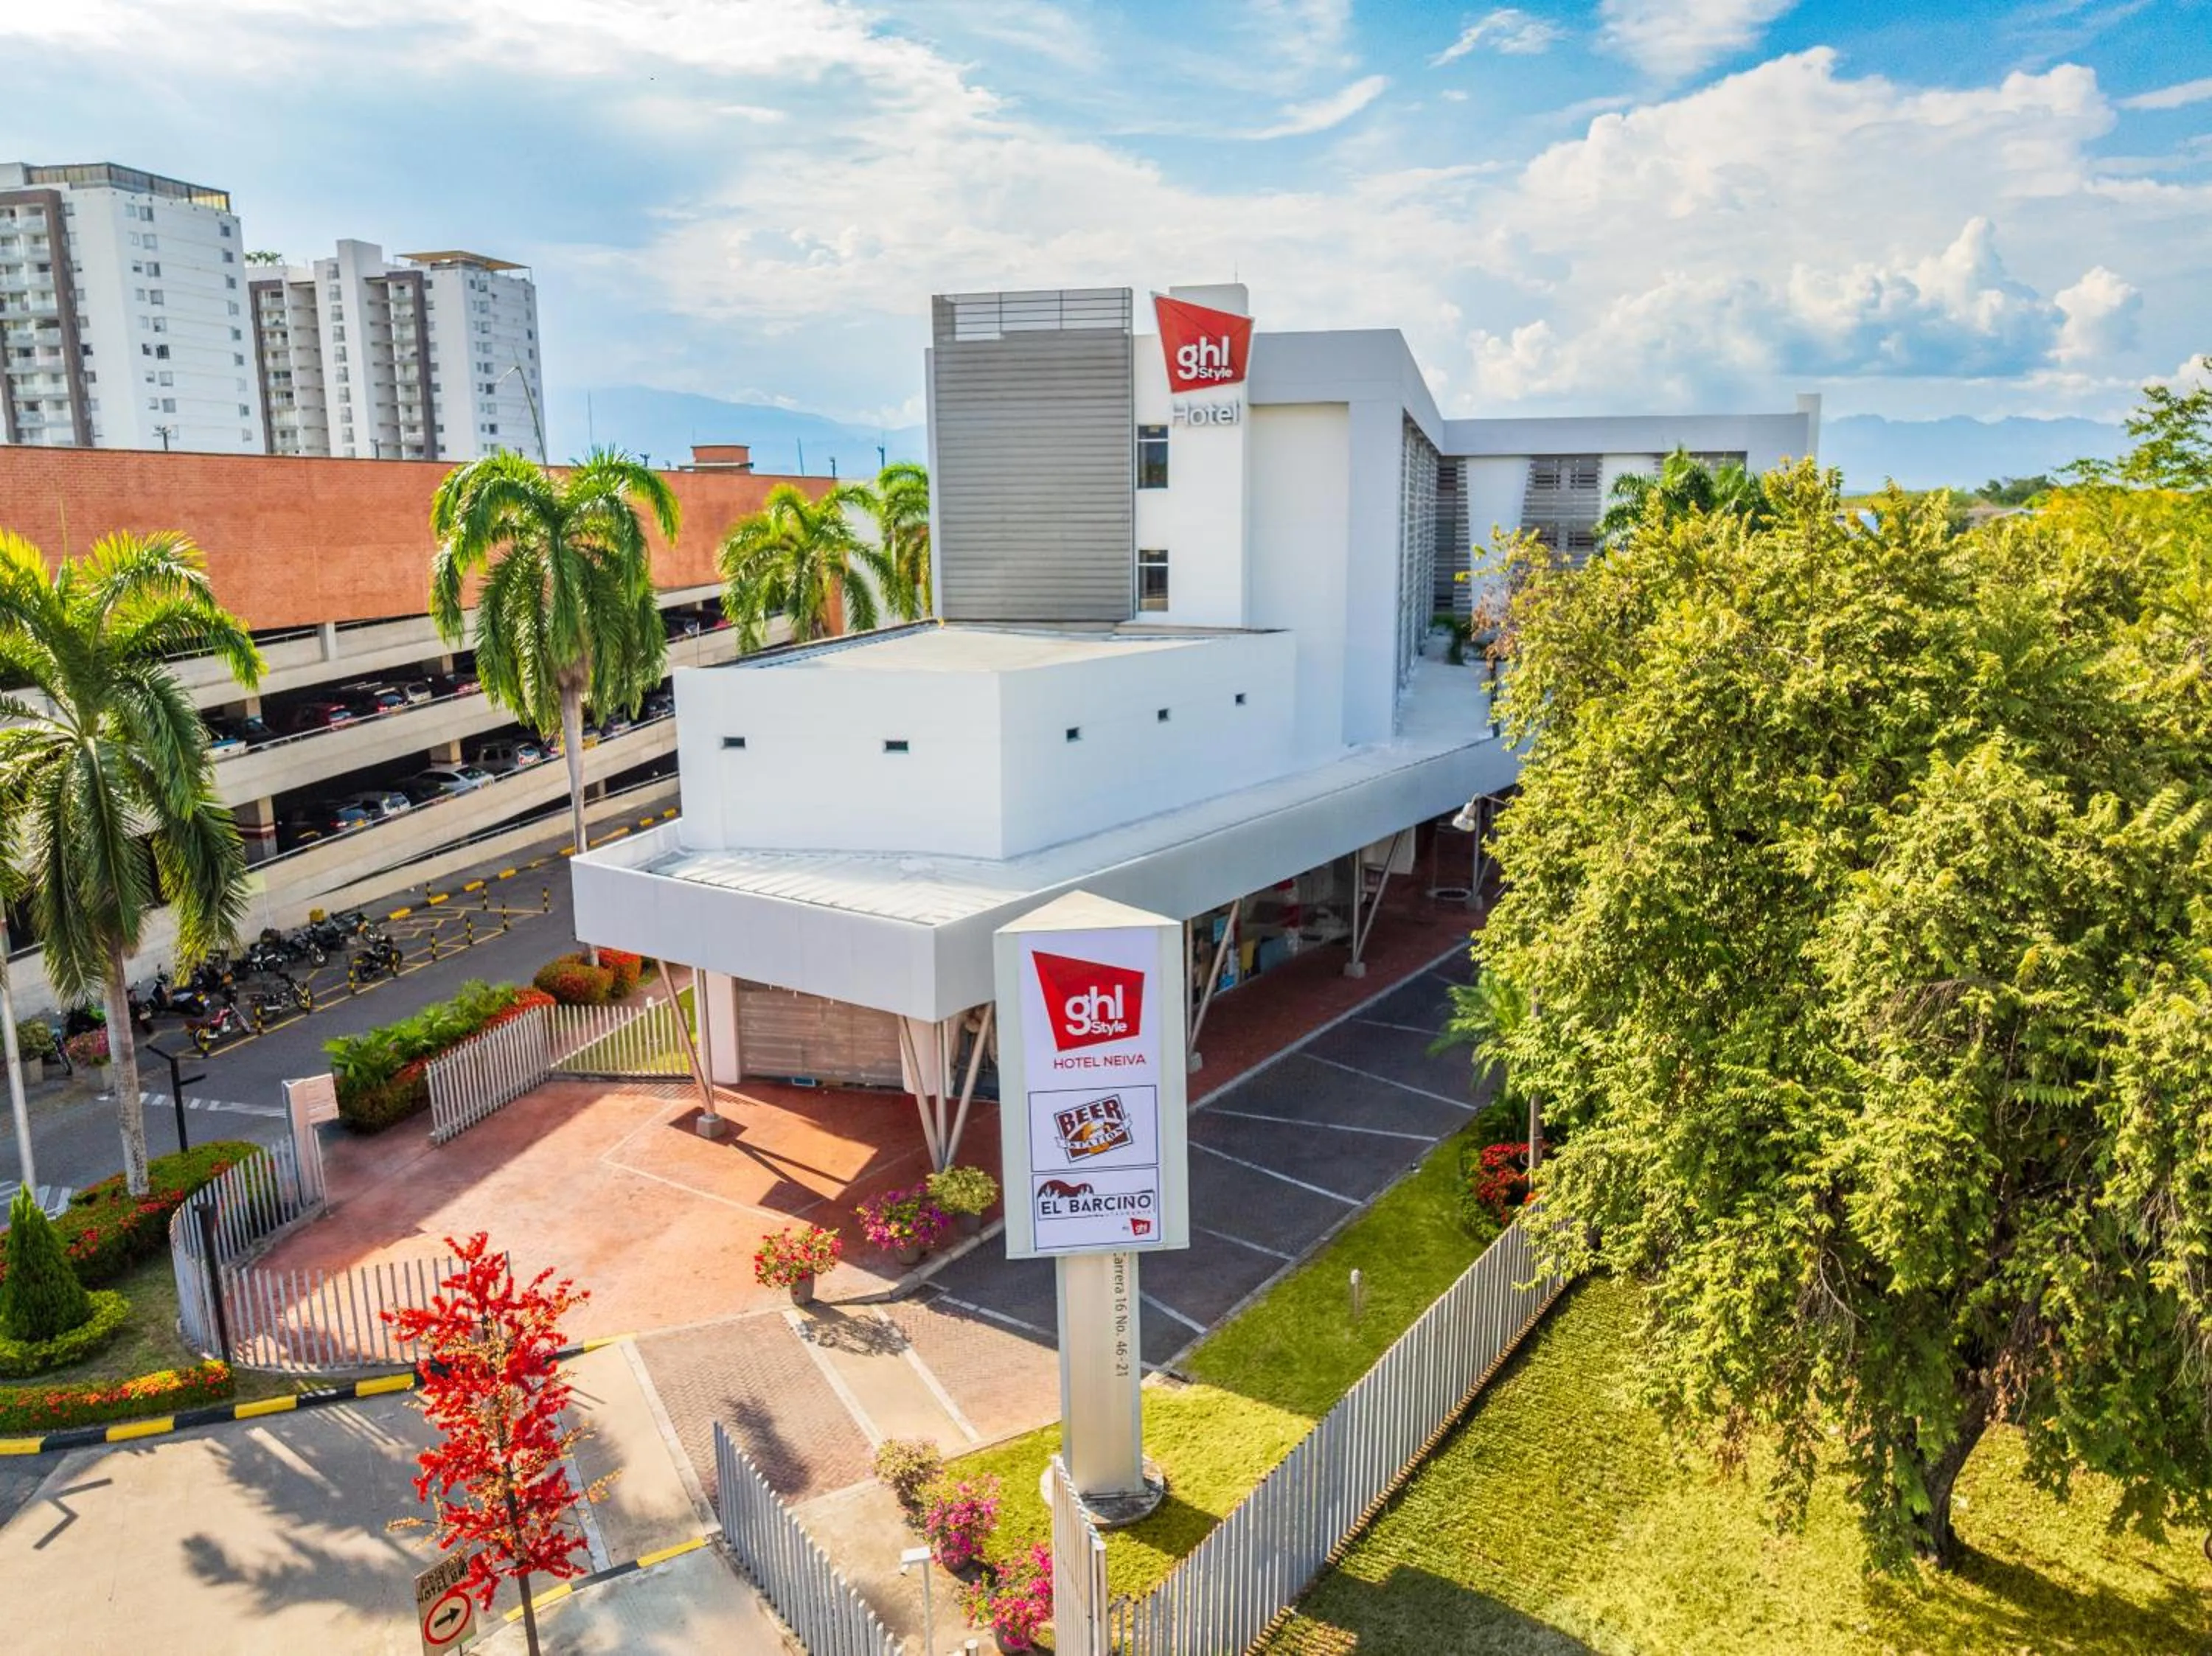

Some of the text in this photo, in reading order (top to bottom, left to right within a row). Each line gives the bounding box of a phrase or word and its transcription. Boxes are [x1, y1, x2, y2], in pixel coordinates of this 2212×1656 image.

[1177, 335, 1229, 380] ghl
[1198, 366, 1234, 381] Style
[1172, 399, 1240, 426] Hotel
[1065, 984, 1124, 1036] ghl
[1091, 1020, 1128, 1036] Style
[1054, 1054, 1147, 1069] HOTEL NEIVA
[1058, 1099, 1124, 1137] BEER
[1041, 1194, 1152, 1215] EL BARCINO
[1115, 1298, 1127, 1312] 16
[1115, 1315, 1128, 1337] No.
[1115, 1340, 1129, 1377] 46-21
